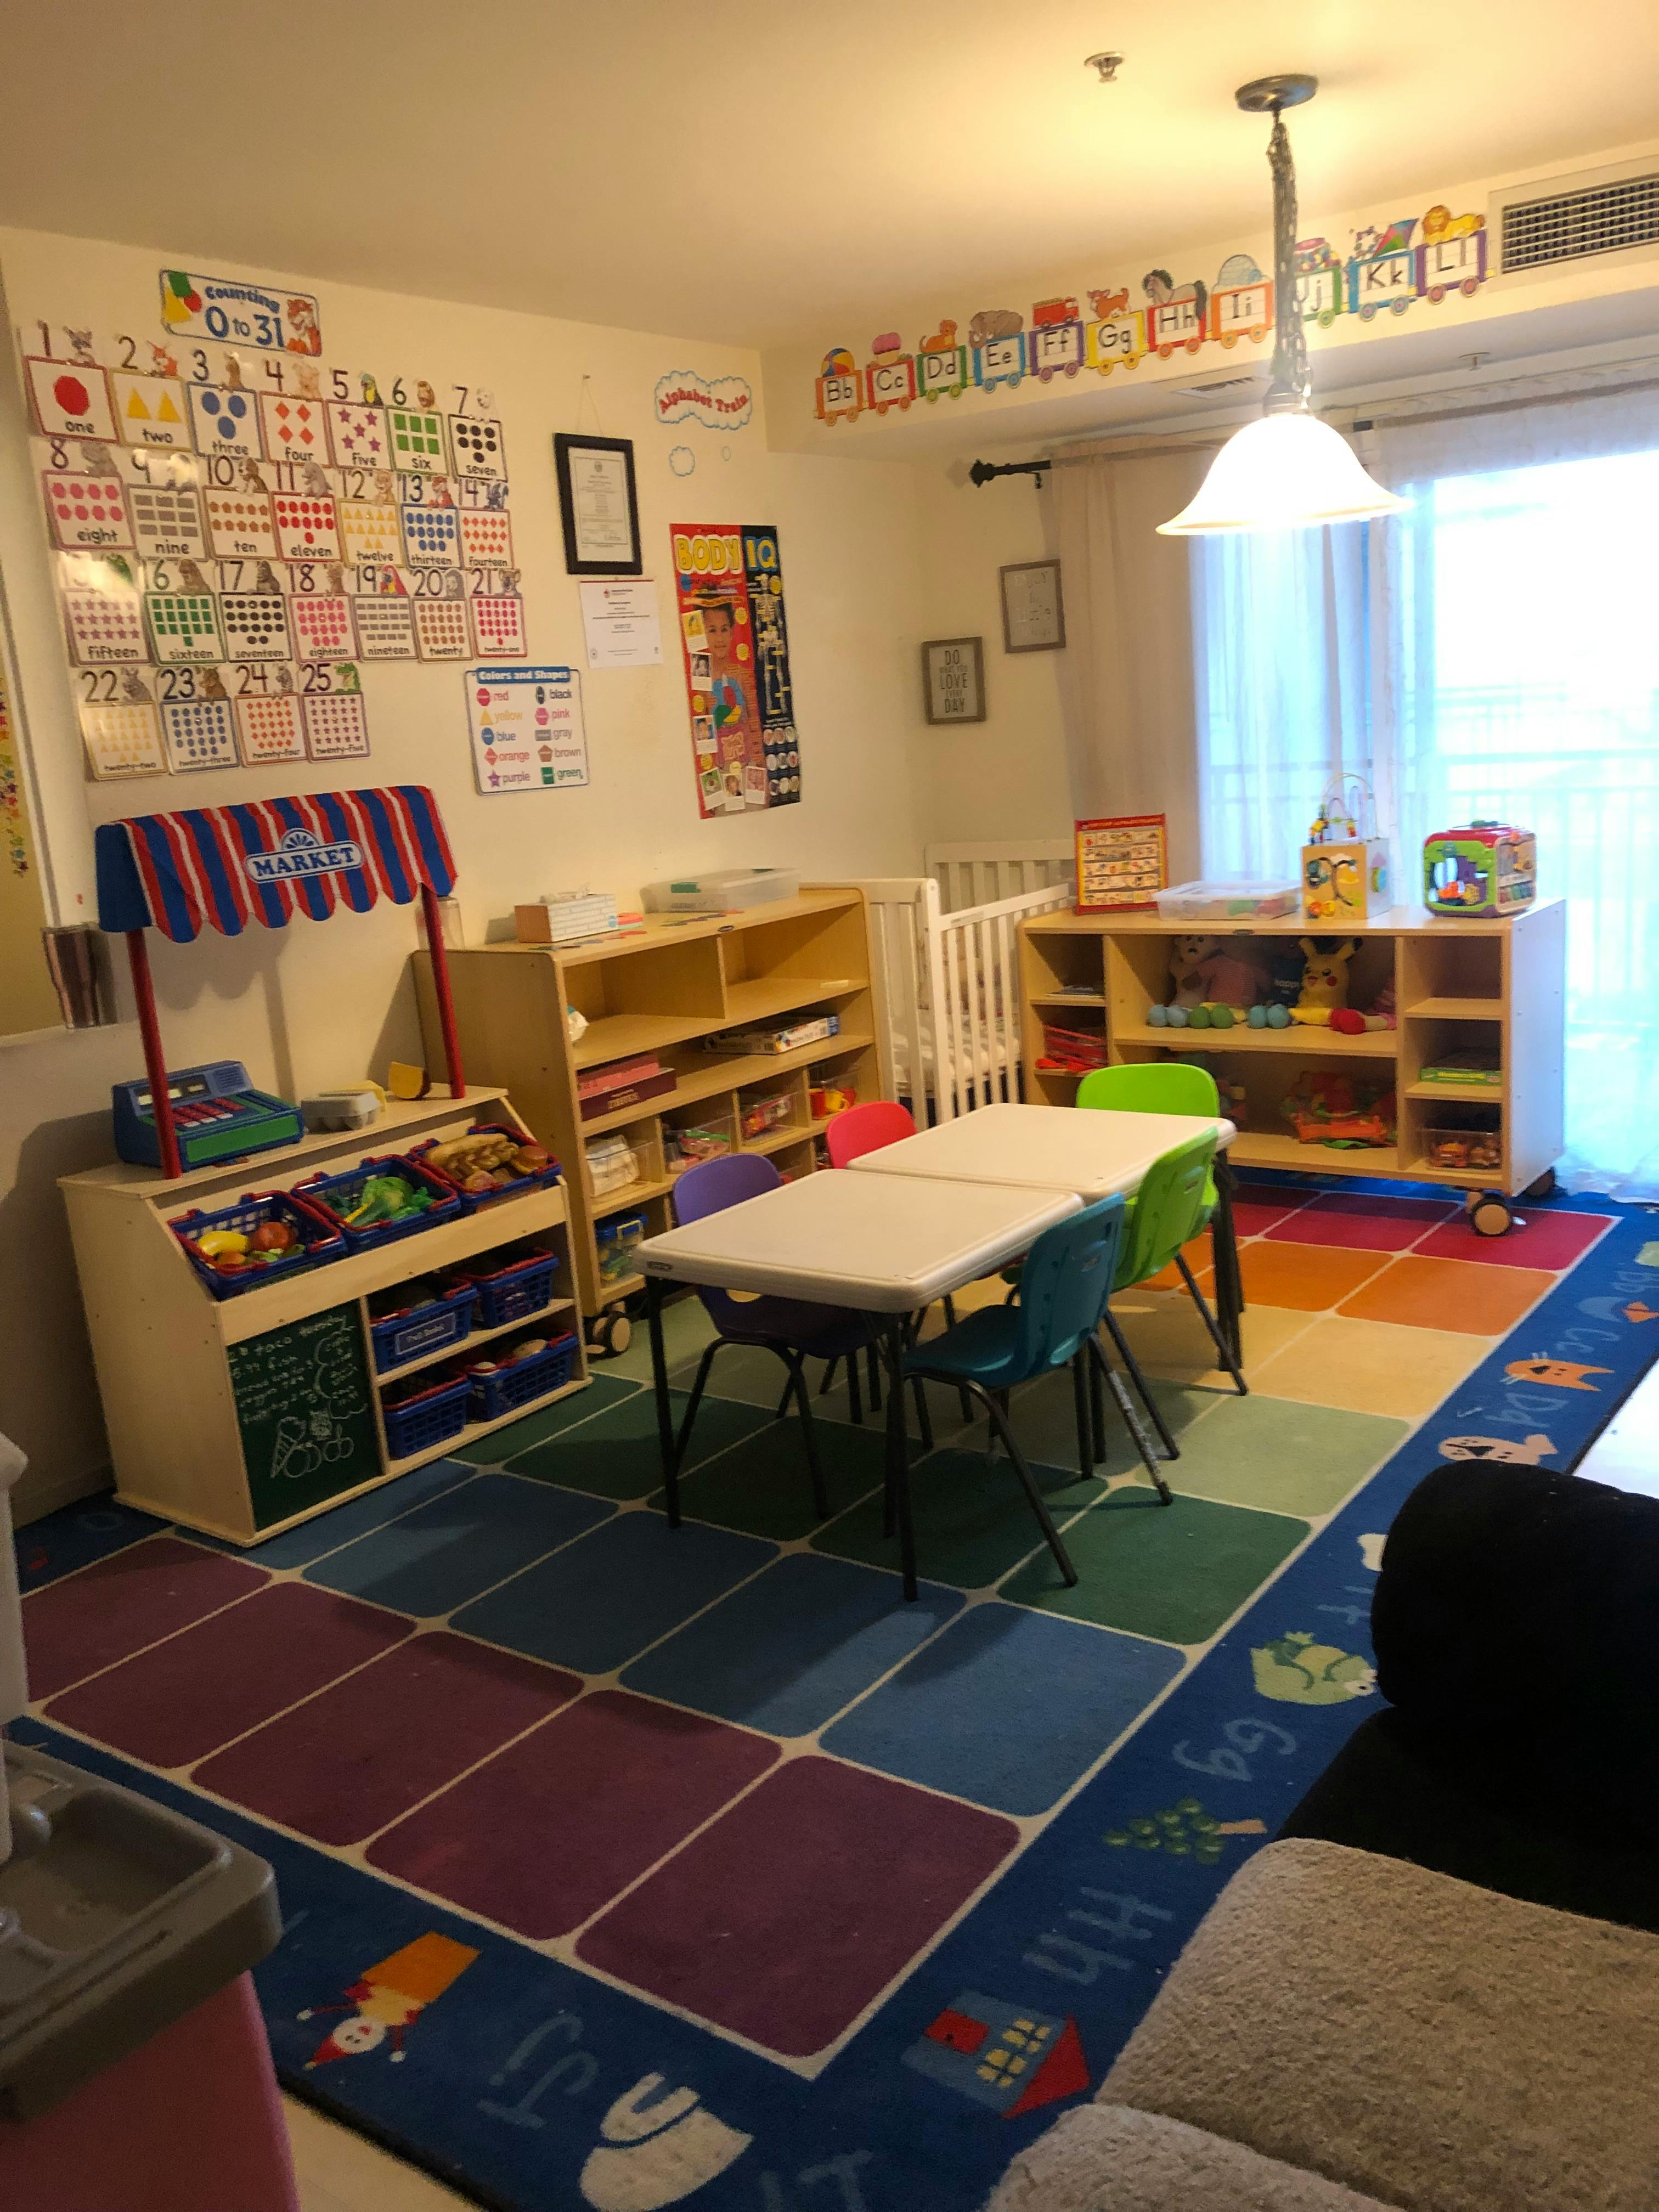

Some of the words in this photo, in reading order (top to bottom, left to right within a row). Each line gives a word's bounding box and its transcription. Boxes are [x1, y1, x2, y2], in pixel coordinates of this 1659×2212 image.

[205, 306, 229, 338] 0
[233, 318, 250, 336] to
[253, 314, 285, 347] 31
[826, 380, 853, 402] Bb
[876, 370, 904, 391] Cc
[927, 356, 957, 379] Dd
[986, 343, 1012, 366] Ee
[1044, 330, 1069, 356] Ff
[1098, 324, 1131, 353] Gg
[1159, 303, 1196, 334] Hh
[1232, 294, 1252, 319] Ii
[1296, 278, 1322, 312] Jj
[1366, 260, 1402, 290] Kk
[1436, 240, 1466, 272] Ll
[39, 321, 51, 356] 1
[119, 336, 137, 369] 2
[193, 349, 208, 380] 3
[266, 359, 284, 391] 4
[333, 370, 348, 399] 5
[393, 377, 407, 405] 6
[455, 386, 467, 413] 7
[65, 422, 94, 433] one
[143, 428, 173, 444] two
[51, 439, 69, 469] 8
[212, 441, 249, 456] three
[285, 448, 313, 461] four
[132, 451, 150, 482] 9
[352, 453, 376, 466] five
[411, 455, 431, 470] six
[207, 456, 234, 485] 10
[276, 462, 294, 490] 11
[466, 465, 496, 476] seven
[342, 470, 365, 498] 12
[402, 475, 422, 502] 13
[459, 479, 477, 506] 14
[76, 529, 117, 544] eight
[155, 541, 189, 555] nine
[234, 541, 257, 553] ten
[290, 545, 332, 557] eleven
[357, 551, 393, 561] twelve
[411, 554, 452, 565] thirteen
[469, 556, 507, 567] fourteen
[675, 537, 741, 573] BODY
[744, 538, 778, 570] IQ
[221, 561, 244, 590] 17
[289, 563, 315, 592] 18
[356, 565, 377, 592] 19
[413, 569, 443, 596] 20
[471, 568, 492, 594] 21
[169, 650, 214, 660] sixteen
[235, 649, 284, 658] seventeen
[309, 647, 348, 657] eighteen
[368, 646, 409, 655] nineteen
[430, 647, 462, 657] twenty
[945, 650, 959, 665] DO
[235, 664, 268, 695] 24
[301, 663, 331, 692] 25
[479, 672, 511, 680] Colors
[514, 671, 532, 679] and
[535, 670, 568, 680] Shapes
[939, 673, 967, 689] LOVE
[79, 670, 118, 702] 22
[160, 668, 195, 699] 23
[494, 691, 509, 701] red
[550, 690, 572, 699] black
[945, 698, 965, 713] DAY
[494, 710, 522, 723] yellow
[552, 709, 570, 720] pink
[497, 732, 516, 741] blue
[553, 729, 572, 740] gray
[253, 749, 301, 759] twenty-four
[499, 751, 529, 763] orange
[555, 748, 581, 757] brown
[503, 772, 531, 785] purple
[557, 769, 581, 780] green
[253, 847, 354, 877] MARKET
[1173, 1717, 1297, 1782] Gg
[1022, 1886, 1176, 1985] Hh
